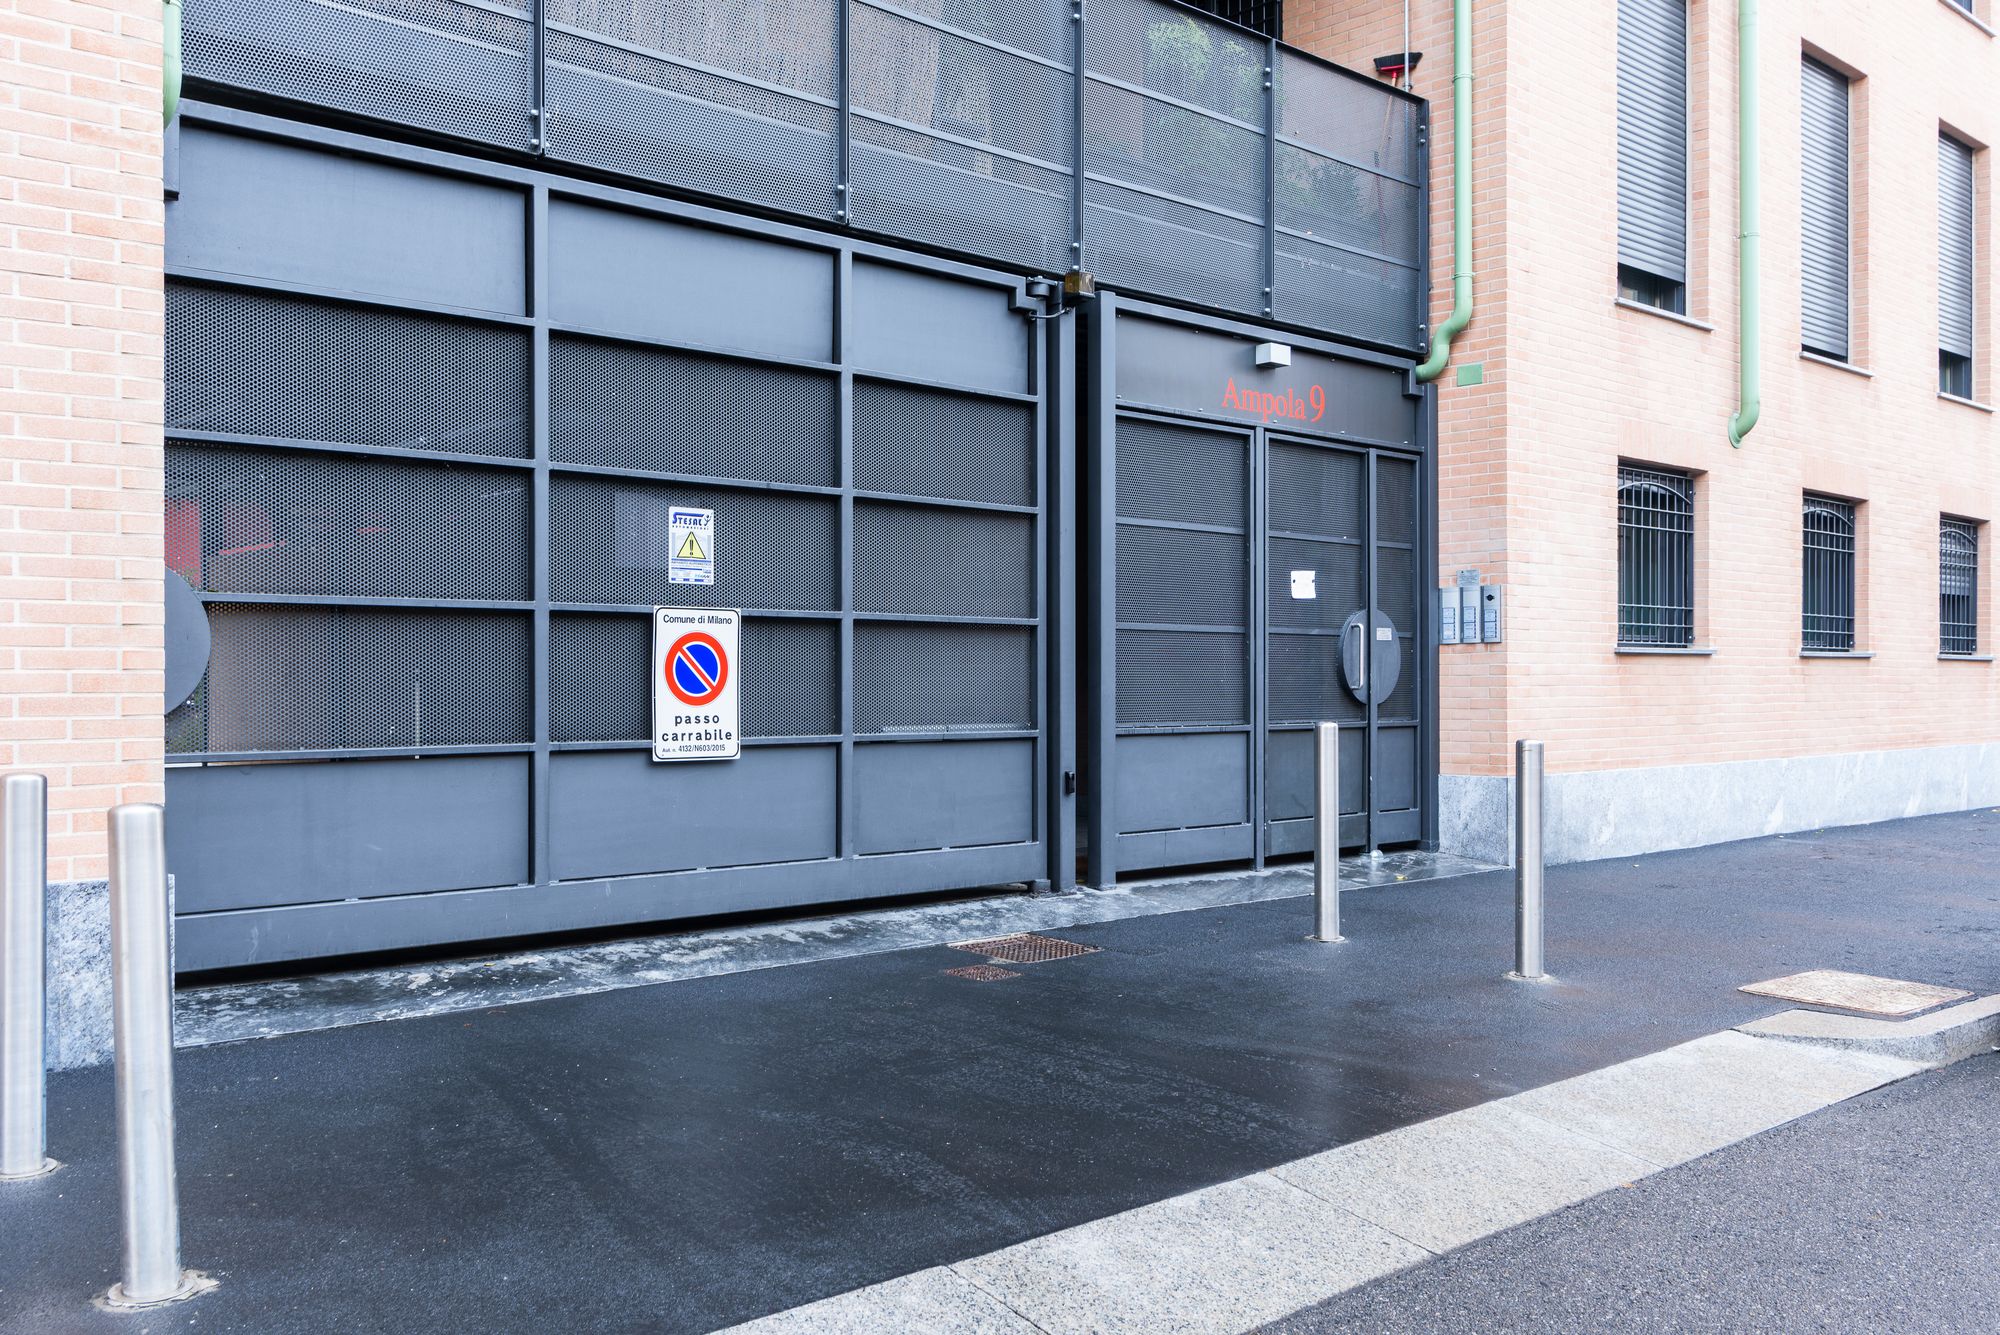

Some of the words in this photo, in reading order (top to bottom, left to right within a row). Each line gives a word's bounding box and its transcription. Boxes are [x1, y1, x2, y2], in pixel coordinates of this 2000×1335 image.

[1221, 377, 1306, 423] Ampola
[1310, 384, 1326, 423] 9
[663, 614, 696, 624] Comune
[697, 615, 706, 624] di
[707, 615, 733, 625] Milano
[674, 715, 720, 727] passo
[661, 729, 732, 742] carrabile
